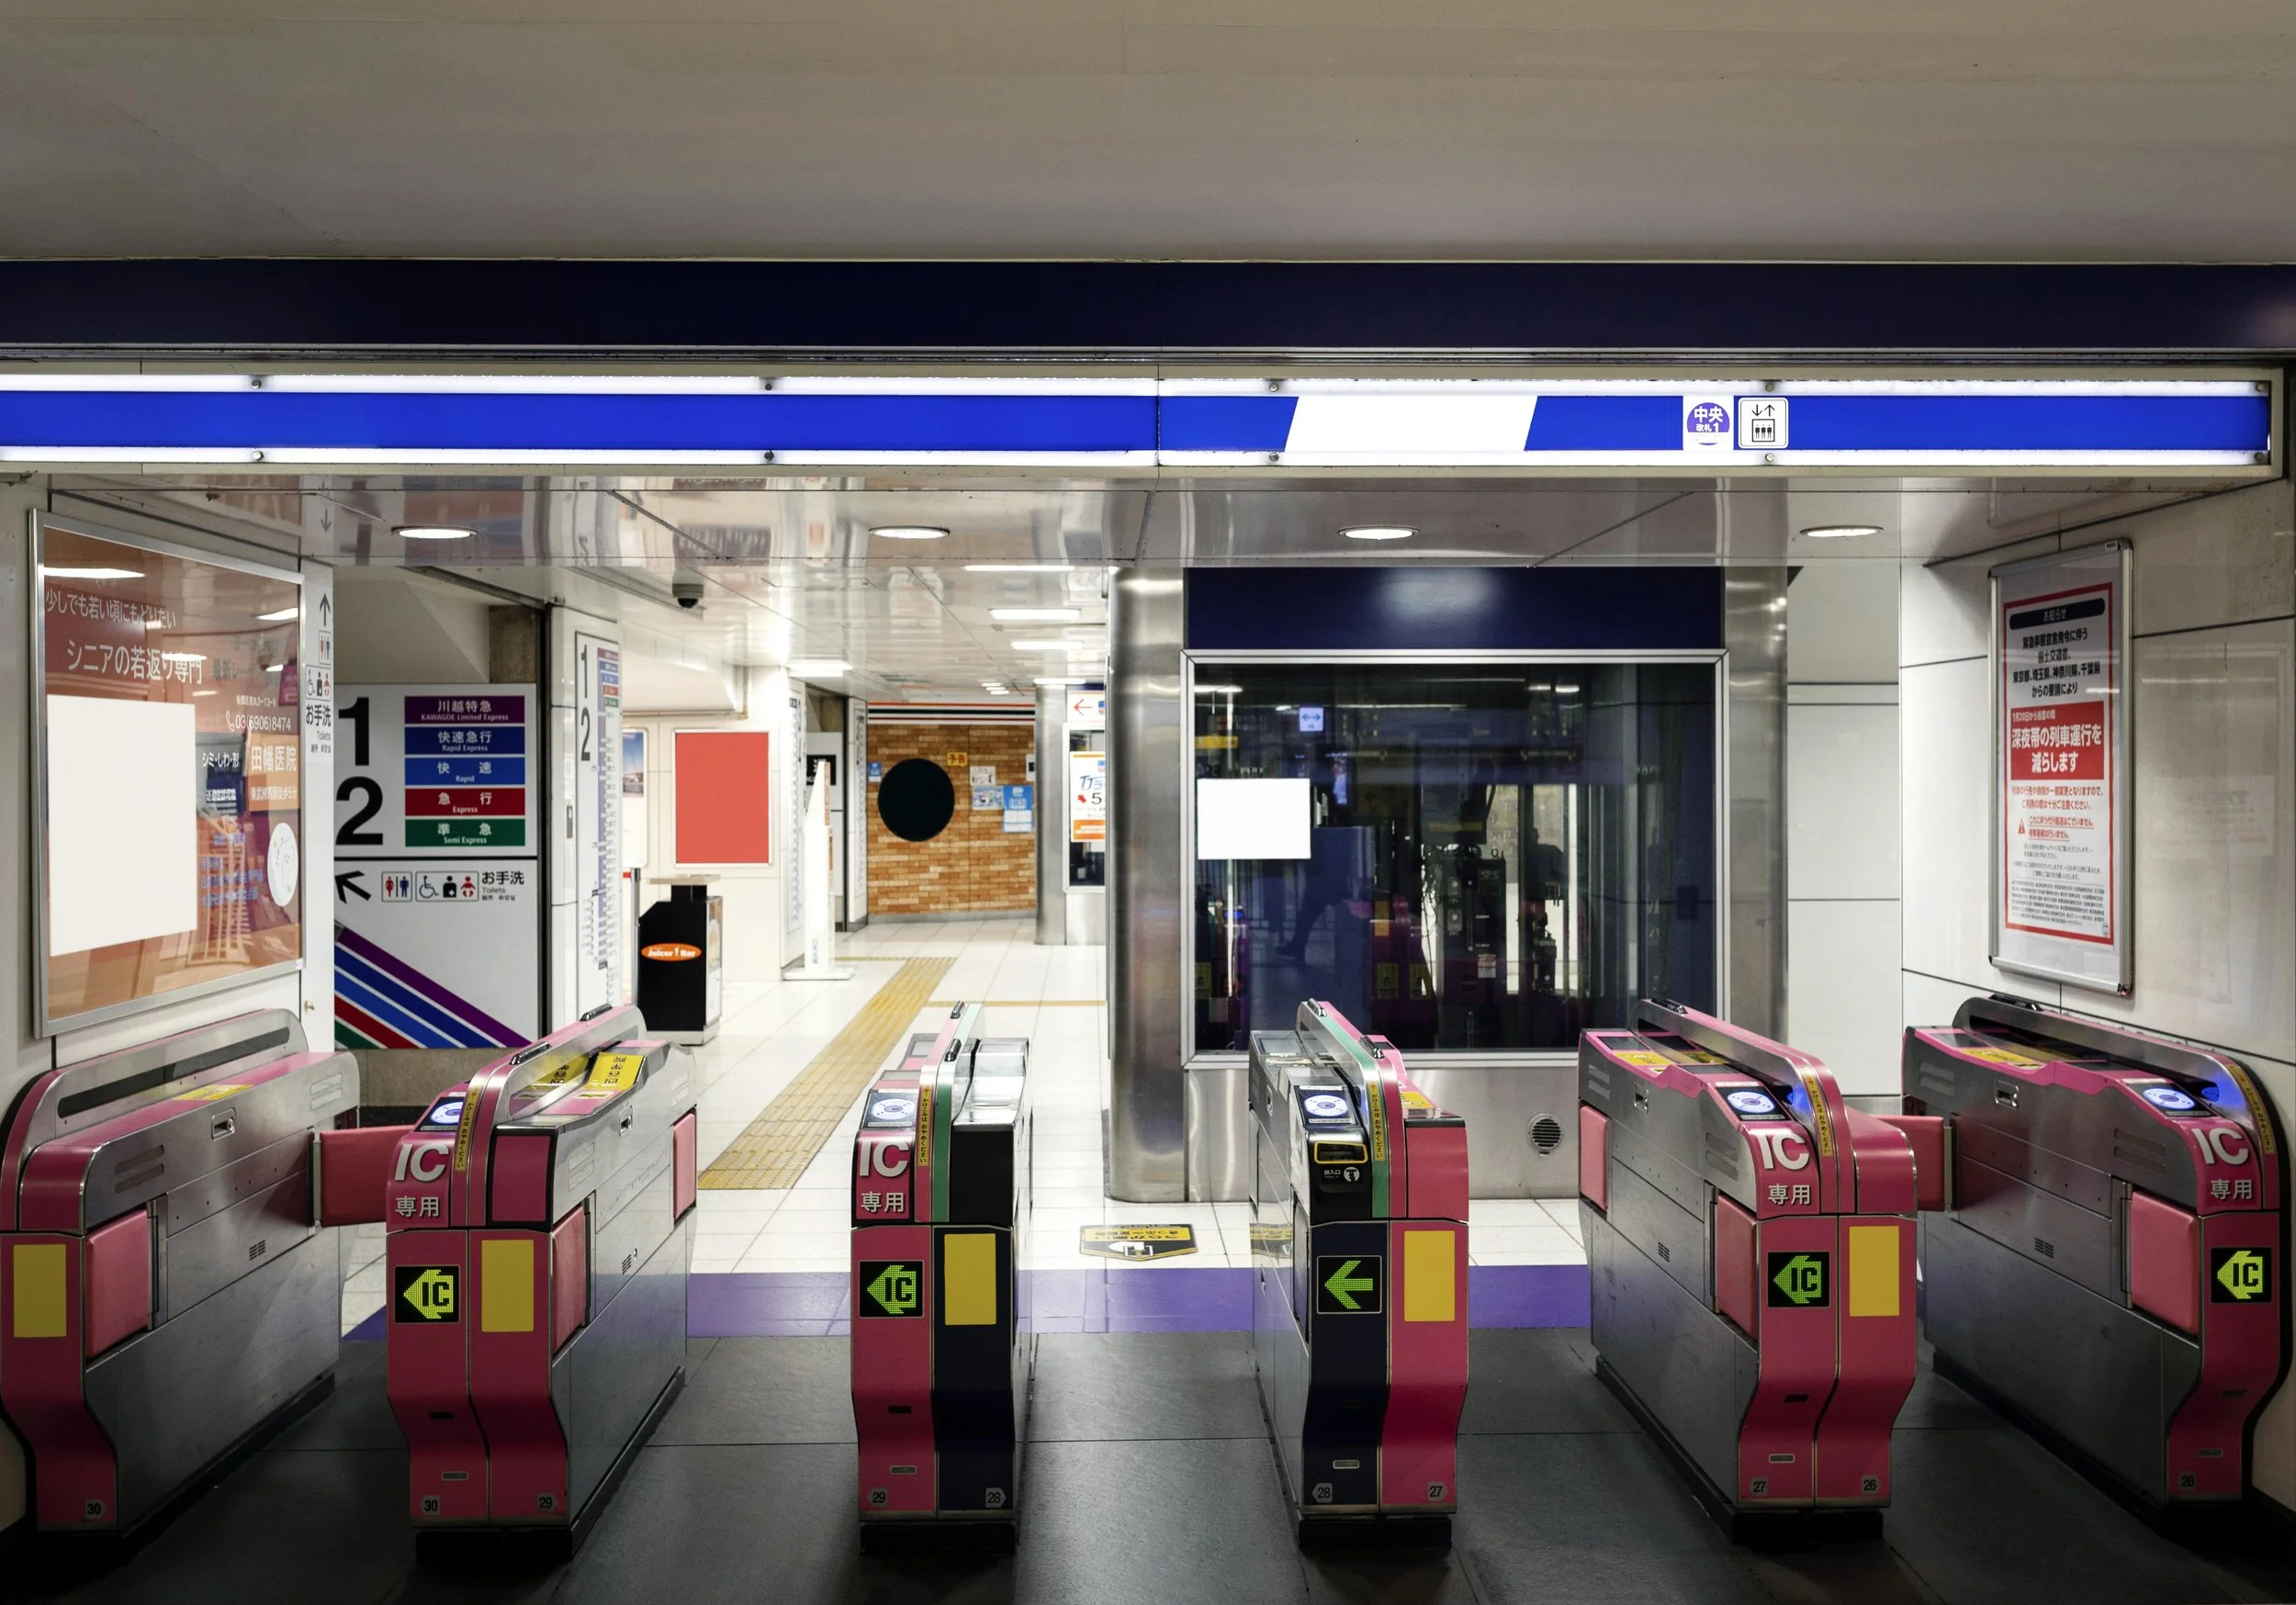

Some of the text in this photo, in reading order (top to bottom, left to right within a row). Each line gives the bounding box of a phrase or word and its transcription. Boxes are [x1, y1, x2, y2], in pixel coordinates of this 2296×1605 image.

[1694, 406, 1723, 422] 中央
[1695, 422, 1719, 432] 改札 1
[2043, 609, 2066, 622] お知らせ
[581, 645, 587, 699] 1
[306, 704, 332, 726] お手洗
[438, 700, 491, 713] 川越特急
[235, 714, 291, 731] 03(6906)8474
[483, 713, 509, 722] Express
[338, 697, 369, 766] 1
[438, 731, 492, 744] 快速急行
[580, 707, 591, 761] 2
[2012, 724, 2101, 749] 深夜帯の列車運行を
[2032, 751, 2078, 773] 減らします
[456, 775, 475, 783] Rapid
[335, 777, 384, 846] 2
[462, 836, 487, 845] Express
[482, 870, 524, 885] お手洗
[680, 949, 696, 958] Bar
[1756, 1131, 1809, 1170] IC
[2191, 1128, 2249, 1165] IC
[395, 1144, 449, 1182] IC
[859, 1139, 909, 1177] IC
[1768, 1184, 1811, 1206] 専用
[2210, 1178, 2253, 1199] 専用
[395, 1195, 439, 1218] 専用
[861, 1191, 905, 1213] 専用
[1792, 1267, 1818, 1292] IC
[2233, 1263, 2259, 1287] IC
[422, 1282, 450, 1307] IC
[884, 1277, 912, 1302] IC
[1318, 1487, 1331, 1498] 28
[1430, 1486, 1443, 1497] 27
[1753, 1481, 1766, 1492] 27
[1863, 1480, 1876, 1491] 26
[424, 1499, 438, 1511] 30
[539, 1497, 552, 1509] 29
[873, 1492, 886, 1503] 29
[987, 1492, 1000, 1503] 28
[87, 1502, 102, 1515] 30
